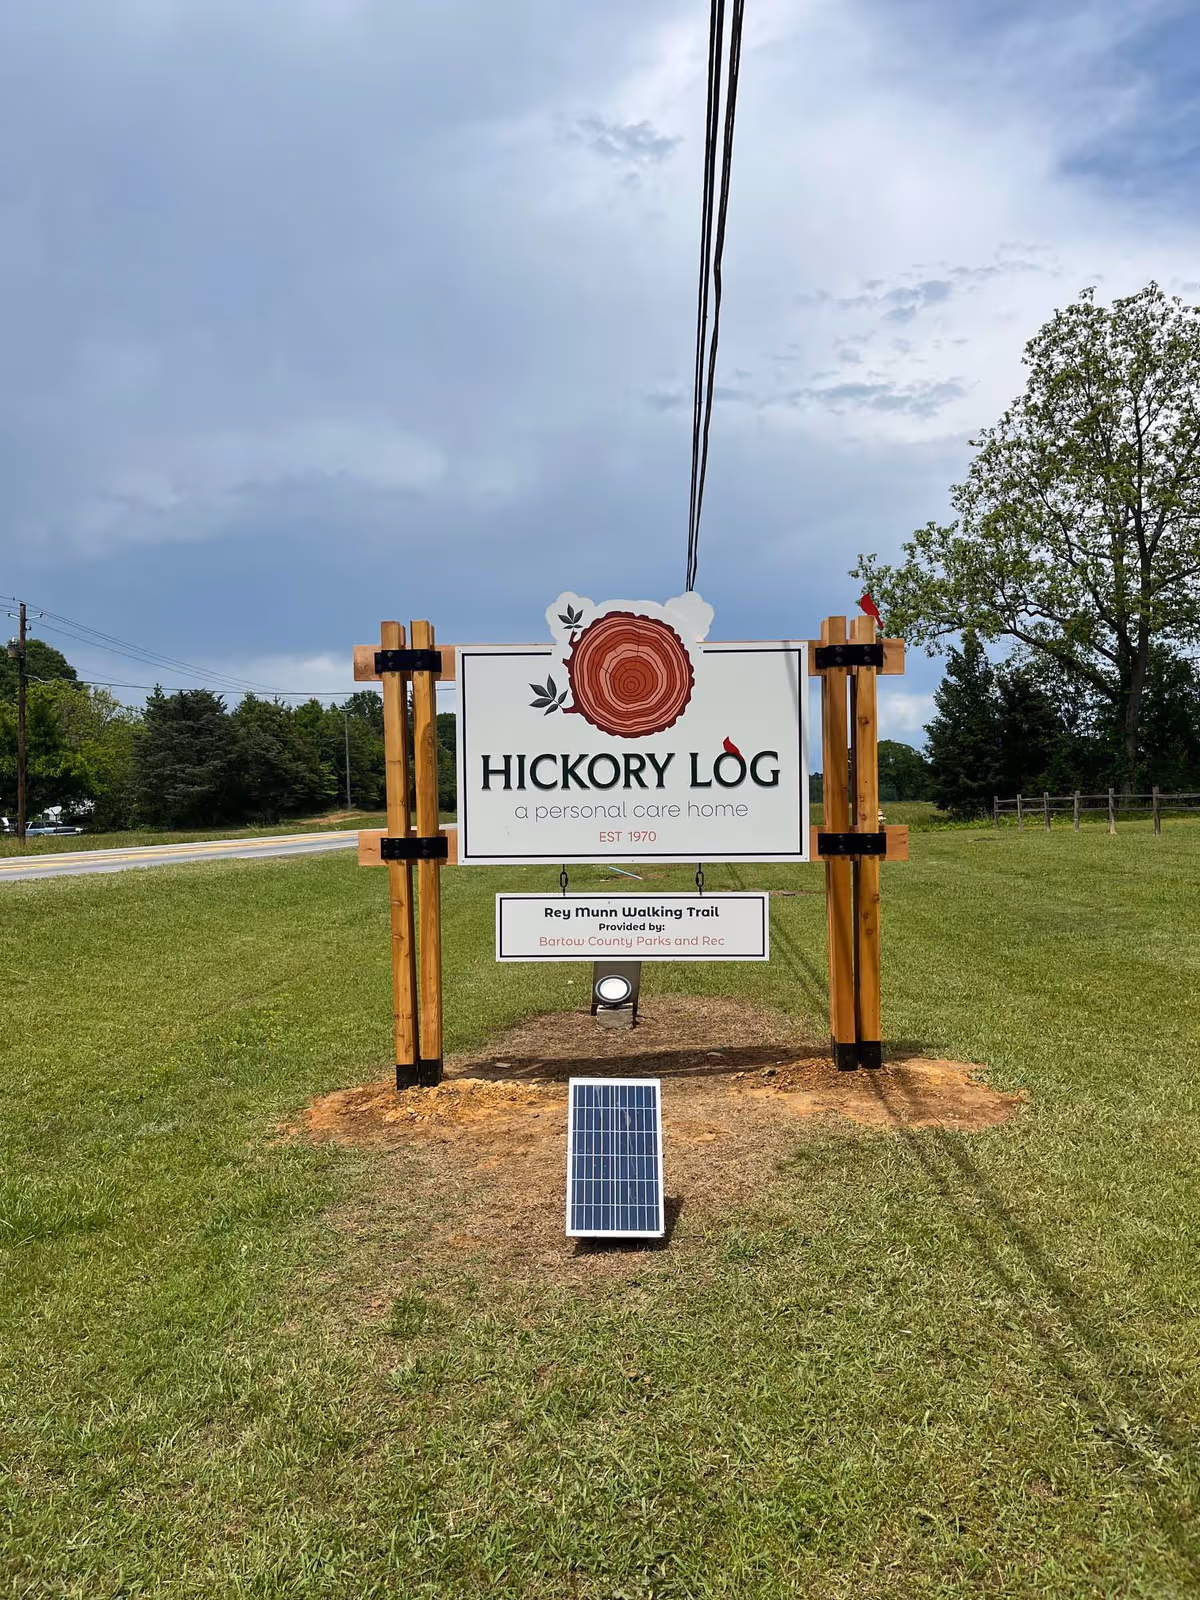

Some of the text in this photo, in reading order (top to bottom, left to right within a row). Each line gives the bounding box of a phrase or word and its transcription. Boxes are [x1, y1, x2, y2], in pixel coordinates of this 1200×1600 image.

[482, 750, 780, 789] HICKORY LOG
[515, 801, 748, 822] a personal care home
[600, 831, 656, 842] EST 1970
[545, 906, 719, 919] Rey Munn Walking Trail
[599, 922, 664, 932] Provided by:
[540, 936, 724, 948] Bartow County Parks and Rec
